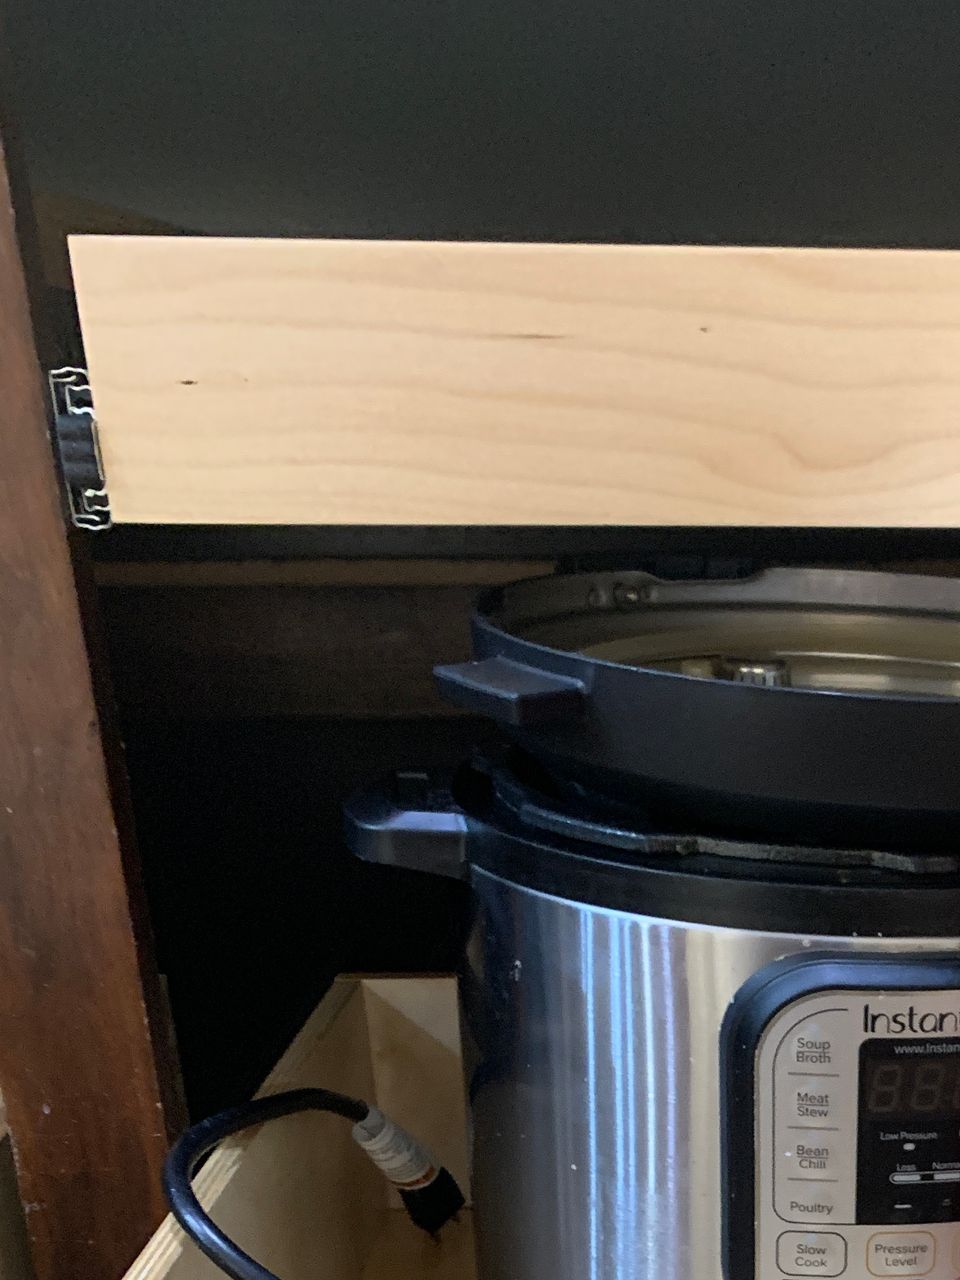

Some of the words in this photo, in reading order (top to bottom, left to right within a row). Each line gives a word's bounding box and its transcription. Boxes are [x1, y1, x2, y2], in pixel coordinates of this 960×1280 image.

[797, 1037, 831, 1052] Soup
[796, 1052, 831, 1064] Broth
[797, 1092, 830, 1105] Meat
[797, 1106, 829, 1118] Stew
[880, 1132, 899, 1141] Low
[900, 1131, 938, 1141] Pressure
[796, 1145, 829, 1157] Bean
[799, 1158, 826, 1169] Chili
[896, 1163, 916, 1172] Less
[790, 1201, 833, 1215] Poultry
[796, 1243, 828, 1255] Slow
[874, 1243, 928, 1255] Pressure
[795, 1256, 828, 1268] Cook
[885, 1256, 917, 1267] Level
